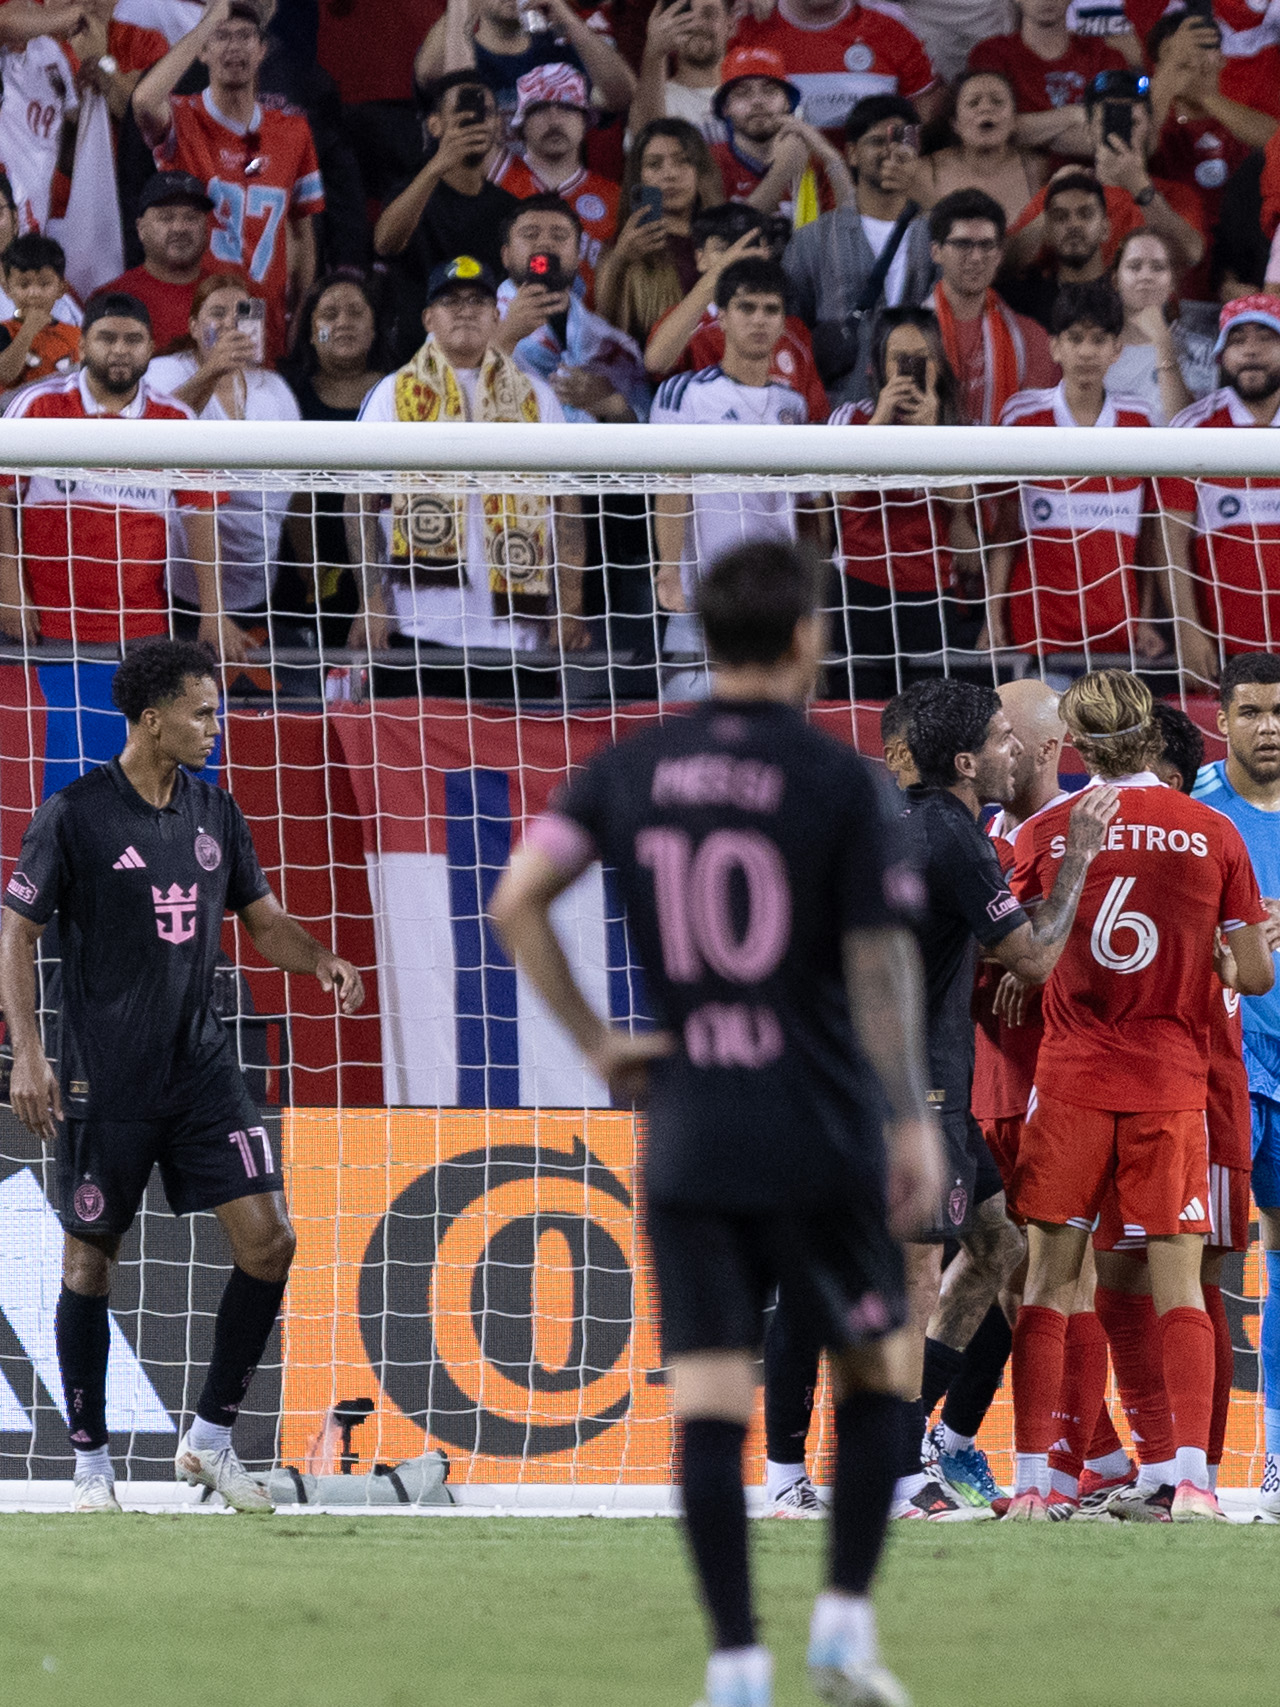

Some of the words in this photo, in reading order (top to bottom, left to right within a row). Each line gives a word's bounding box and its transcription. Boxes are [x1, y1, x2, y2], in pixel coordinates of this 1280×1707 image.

[1050, 818, 1208, 858] SÉTROS
[634, 826, 793, 985] 10
[1090, 876, 1159, 975] 6
[228, 1126, 274, 1178] 17
